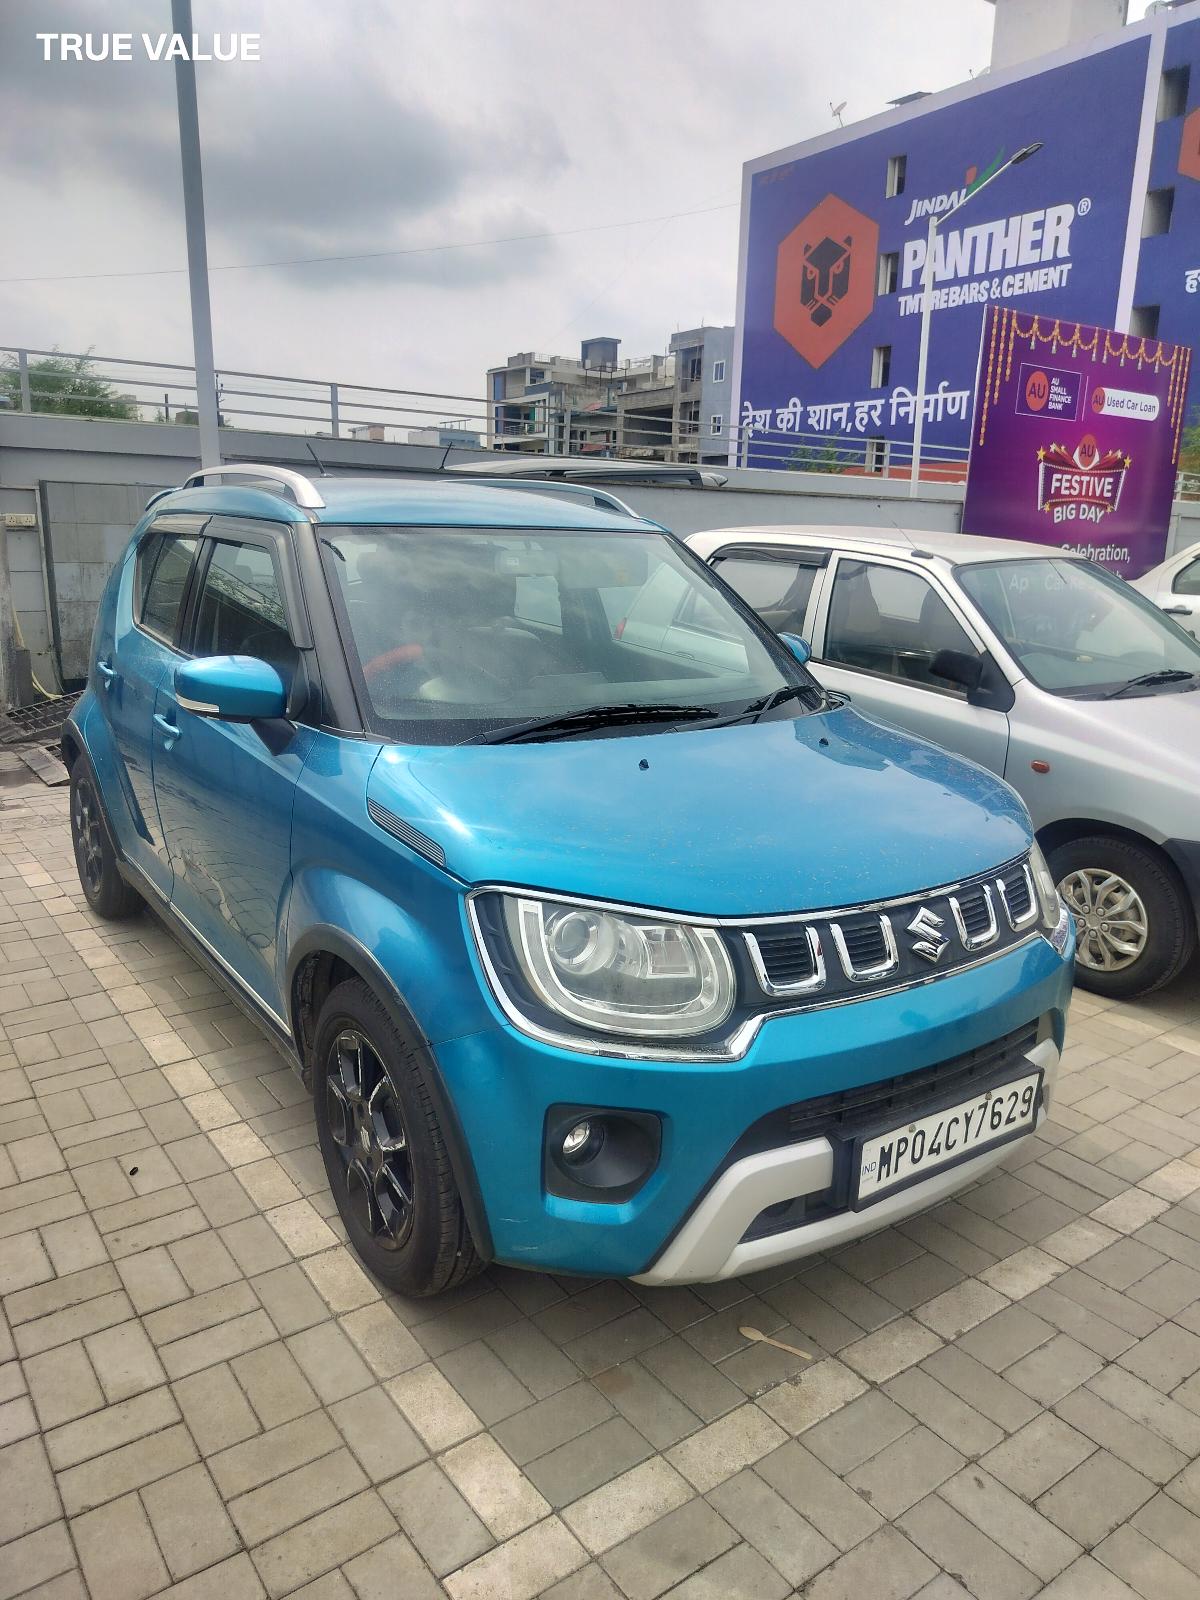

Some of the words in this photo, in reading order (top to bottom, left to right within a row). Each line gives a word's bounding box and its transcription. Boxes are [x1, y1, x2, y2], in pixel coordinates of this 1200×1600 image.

[902, 203, 1076, 289] PANTHER
[1002, 263, 1073, 298] CEMENT
[1051, 377, 1060, 385] AU
[1028, 383, 1046, 399] AU
[1050, 385, 1066, 395] SMALL
[1048, 401, 1062, 410] BANK
[1049, 394, 1072, 404] FINANCE
[1106, 396, 1125, 409] Used
[1126, 399, 1139, 411] Car
[1139, 402, 1156, 413] Loan
[775, 397, 803, 432] की
[1080, 443, 1095, 458] AU
[1051, 473, 1113, 497] FESTIVE
[1053, 503, 1076, 524] BIG
[1079, 503, 1105, 524] DAY
[877, 1085, 1034, 1183] MP04CY7629
[862, 1161, 877, 1177] IND
